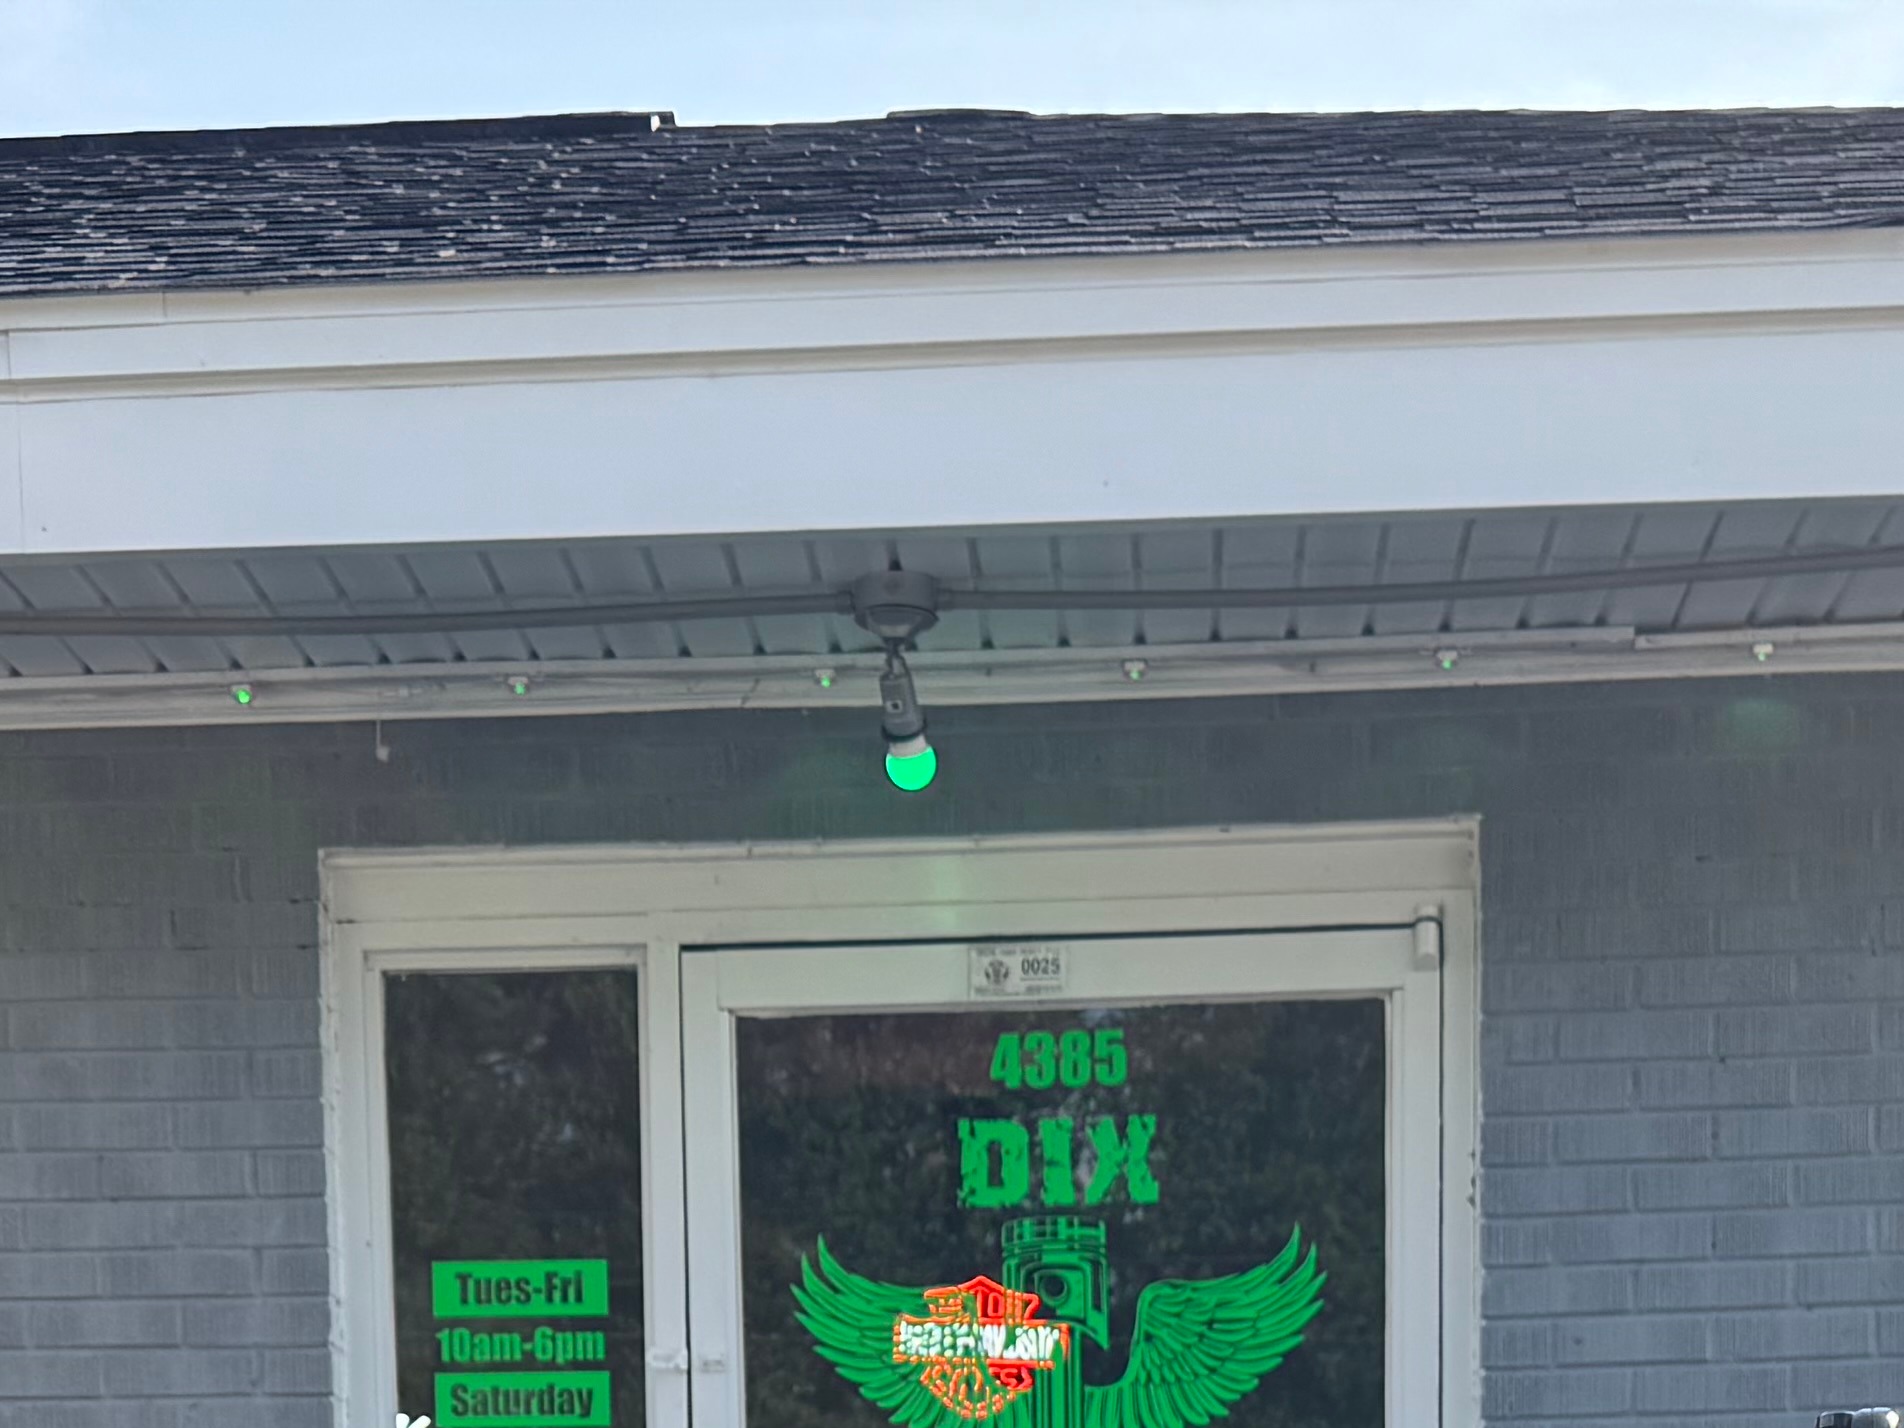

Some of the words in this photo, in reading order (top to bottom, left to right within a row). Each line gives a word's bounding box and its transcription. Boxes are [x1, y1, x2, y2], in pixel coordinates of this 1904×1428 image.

[989, 1028, 1128, 1090] 4385
[956, 1114, 1160, 1208] DIX
[455, 1270, 584, 1306] Tues-Fri
[436, 1327, 606, 1364] 10am-6pm
[450, 1383, 594, 1419] Saturday
